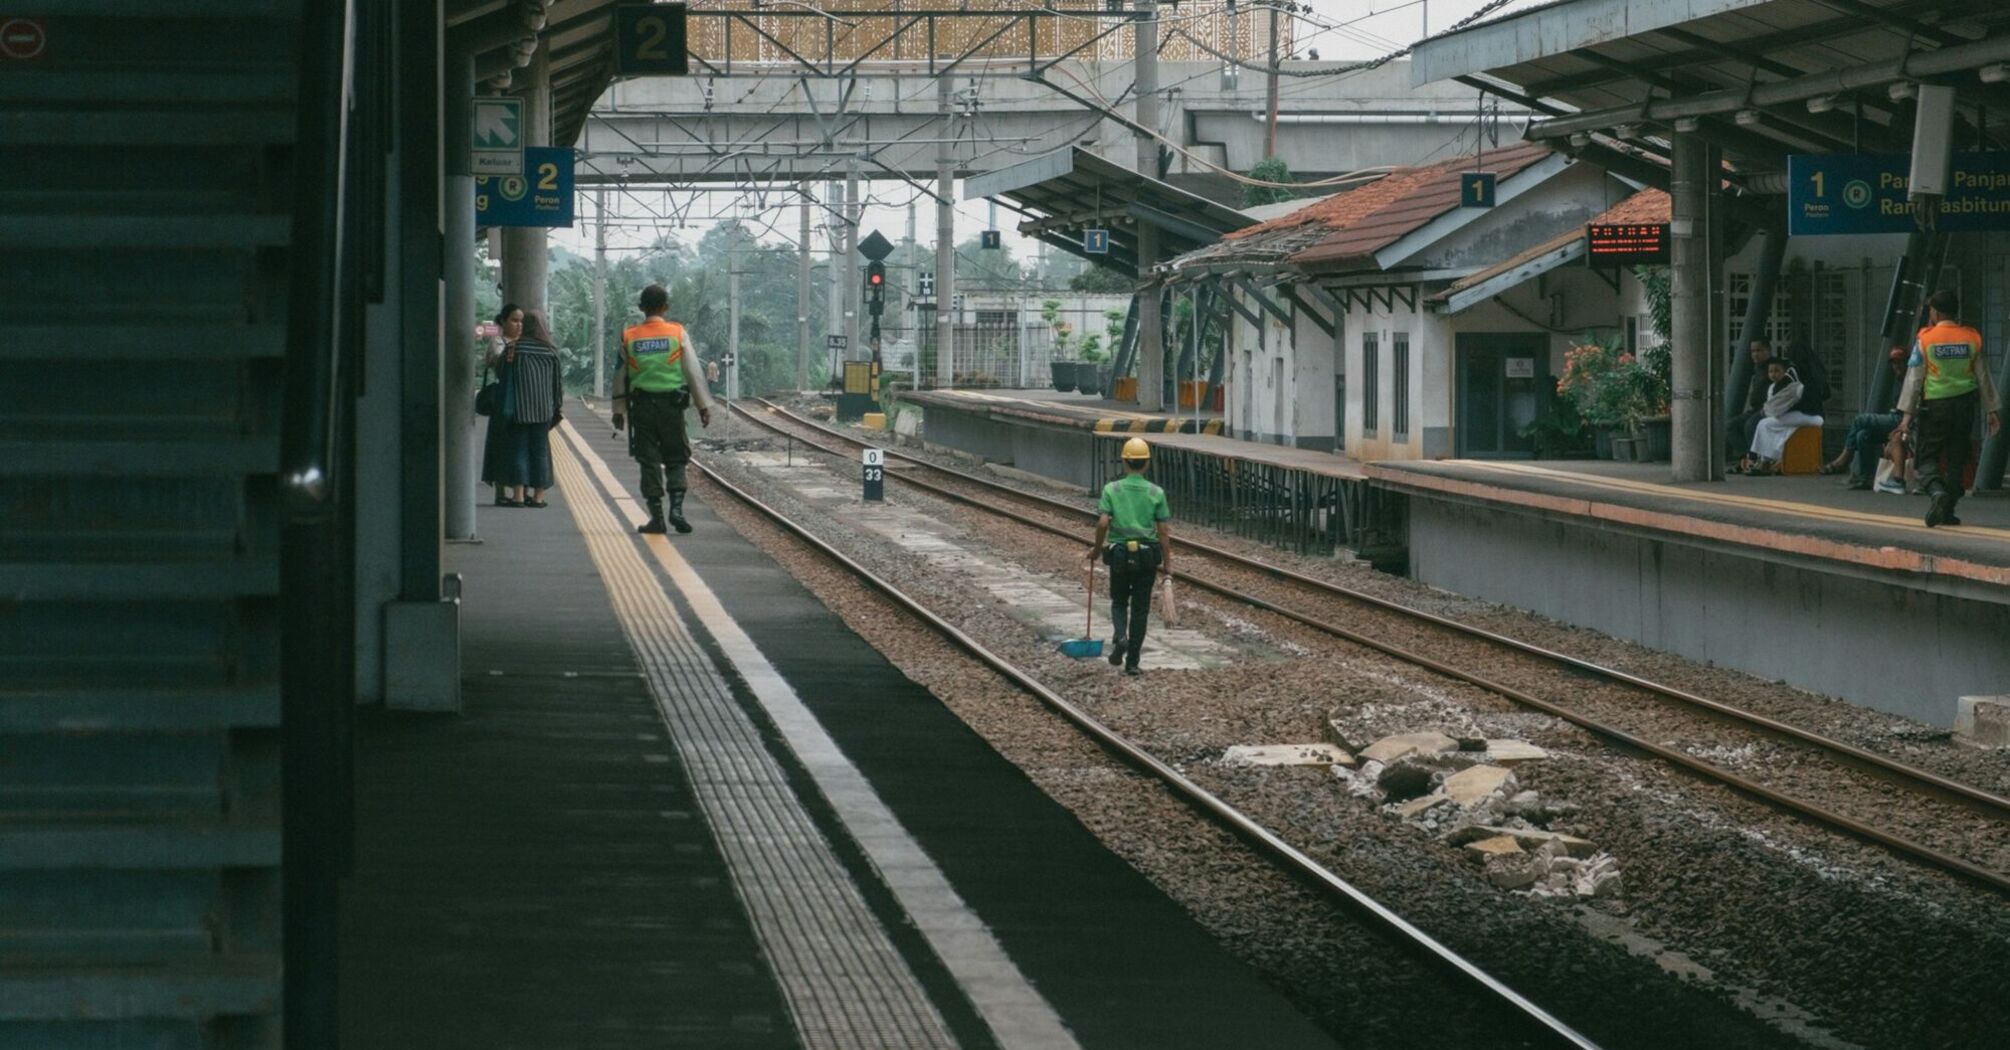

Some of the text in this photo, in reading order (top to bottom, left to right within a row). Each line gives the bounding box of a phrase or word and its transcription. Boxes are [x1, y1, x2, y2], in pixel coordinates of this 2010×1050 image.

[634, 16, 668, 60] 2
[537, 163, 558, 190] 2
[1954, 170, 2010, 191] Panja
[1472, 180, 1483, 202] 1
[1811, 171, 1824, 197] 1
[1804, 203, 1829, 211] Peron
[1881, 195, 2010, 215] Ranasbitun
[987, 233, 995, 245] 1
[1094, 234, 1102, 248] 1
[635, 340, 668, 352] SATPAM
[1935, 345, 1968, 357] SATPAM
[869, 451, 877, 464] 0
[865, 468, 882, 481] 33
